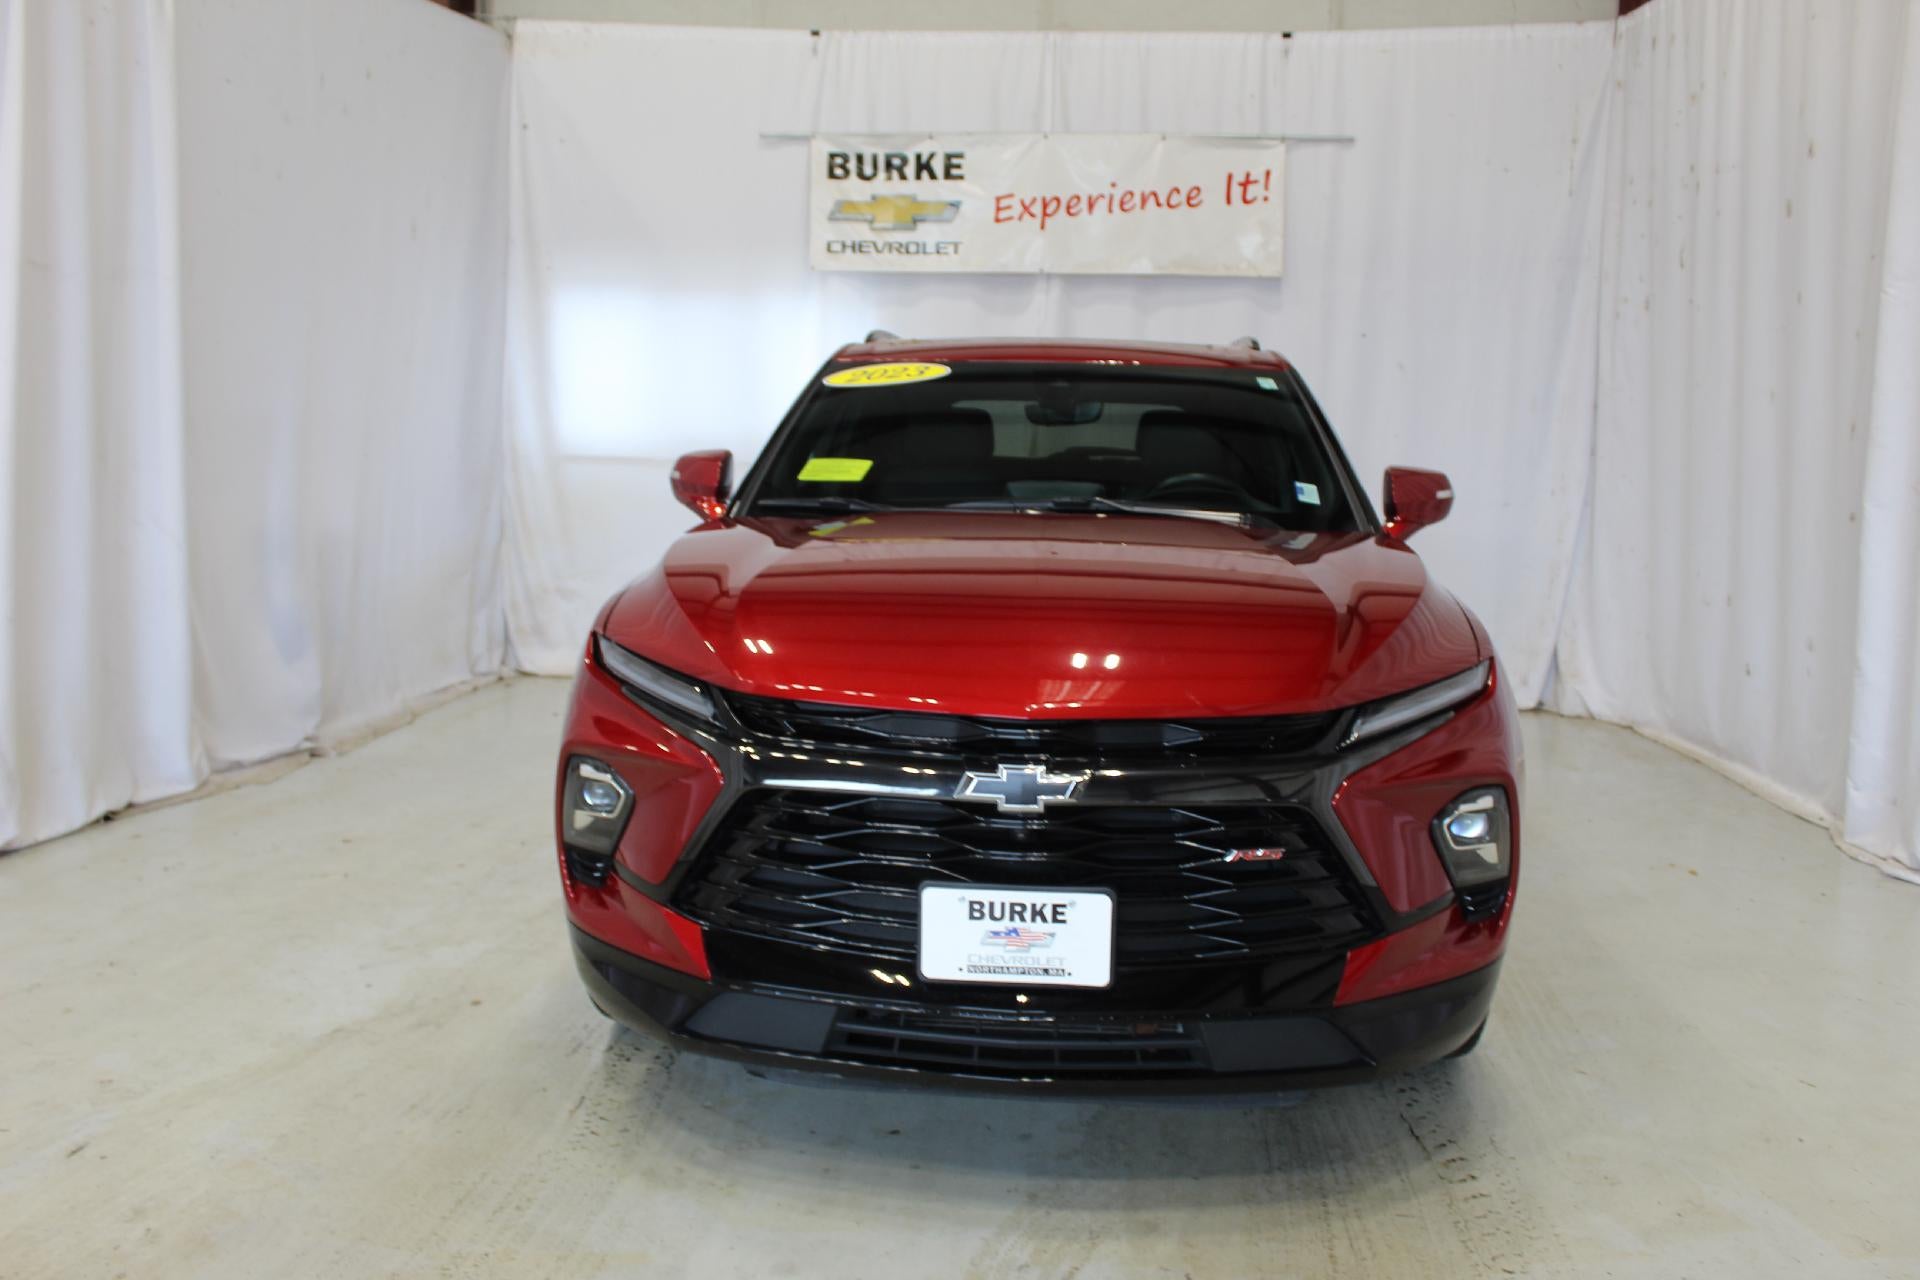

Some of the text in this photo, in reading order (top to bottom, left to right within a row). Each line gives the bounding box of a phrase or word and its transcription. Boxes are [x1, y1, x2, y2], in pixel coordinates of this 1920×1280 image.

[827, 152, 965, 181] BURKE
[994, 169, 1273, 231] Experience It!
[826, 240, 963, 256] CHEVROLET
[845, 365, 931, 383] 2023
[968, 900, 1067, 924] BURKE
[967, 953, 1067, 967] CHEVROLET
